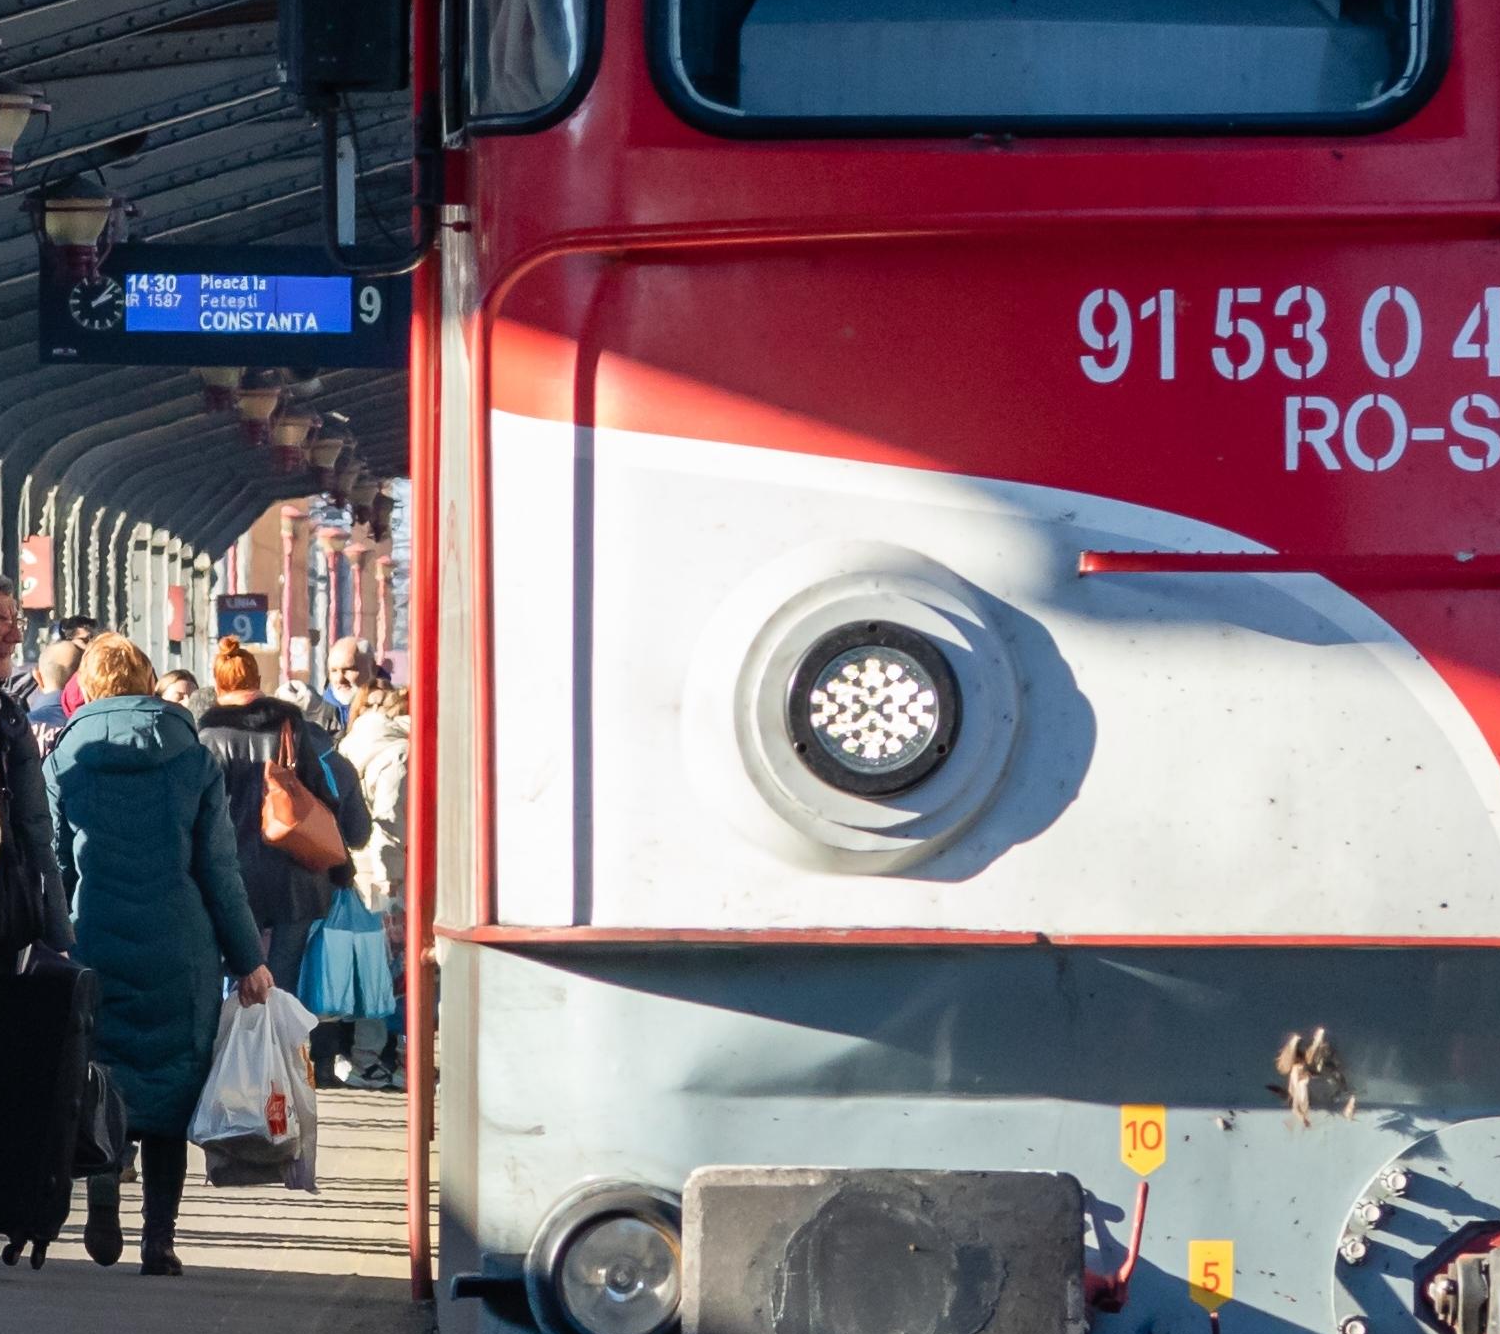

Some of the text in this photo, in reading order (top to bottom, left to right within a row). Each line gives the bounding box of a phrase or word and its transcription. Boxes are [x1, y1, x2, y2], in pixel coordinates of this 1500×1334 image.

[127, 273, 178, 293] 14:30
[253, 274, 267, 290] la
[147, 293, 183, 308] 1587
[358, 284, 383, 324] 9
[1078, 287, 1178, 383] 91
[1211, 286, 1328, 381] 53
[1360, 285, 1423, 379] 0
[232, 614, 254, 643] 9
[1125, 1120, 1163, 1151] 10
[1202, 1262, 1221, 1293] 5
